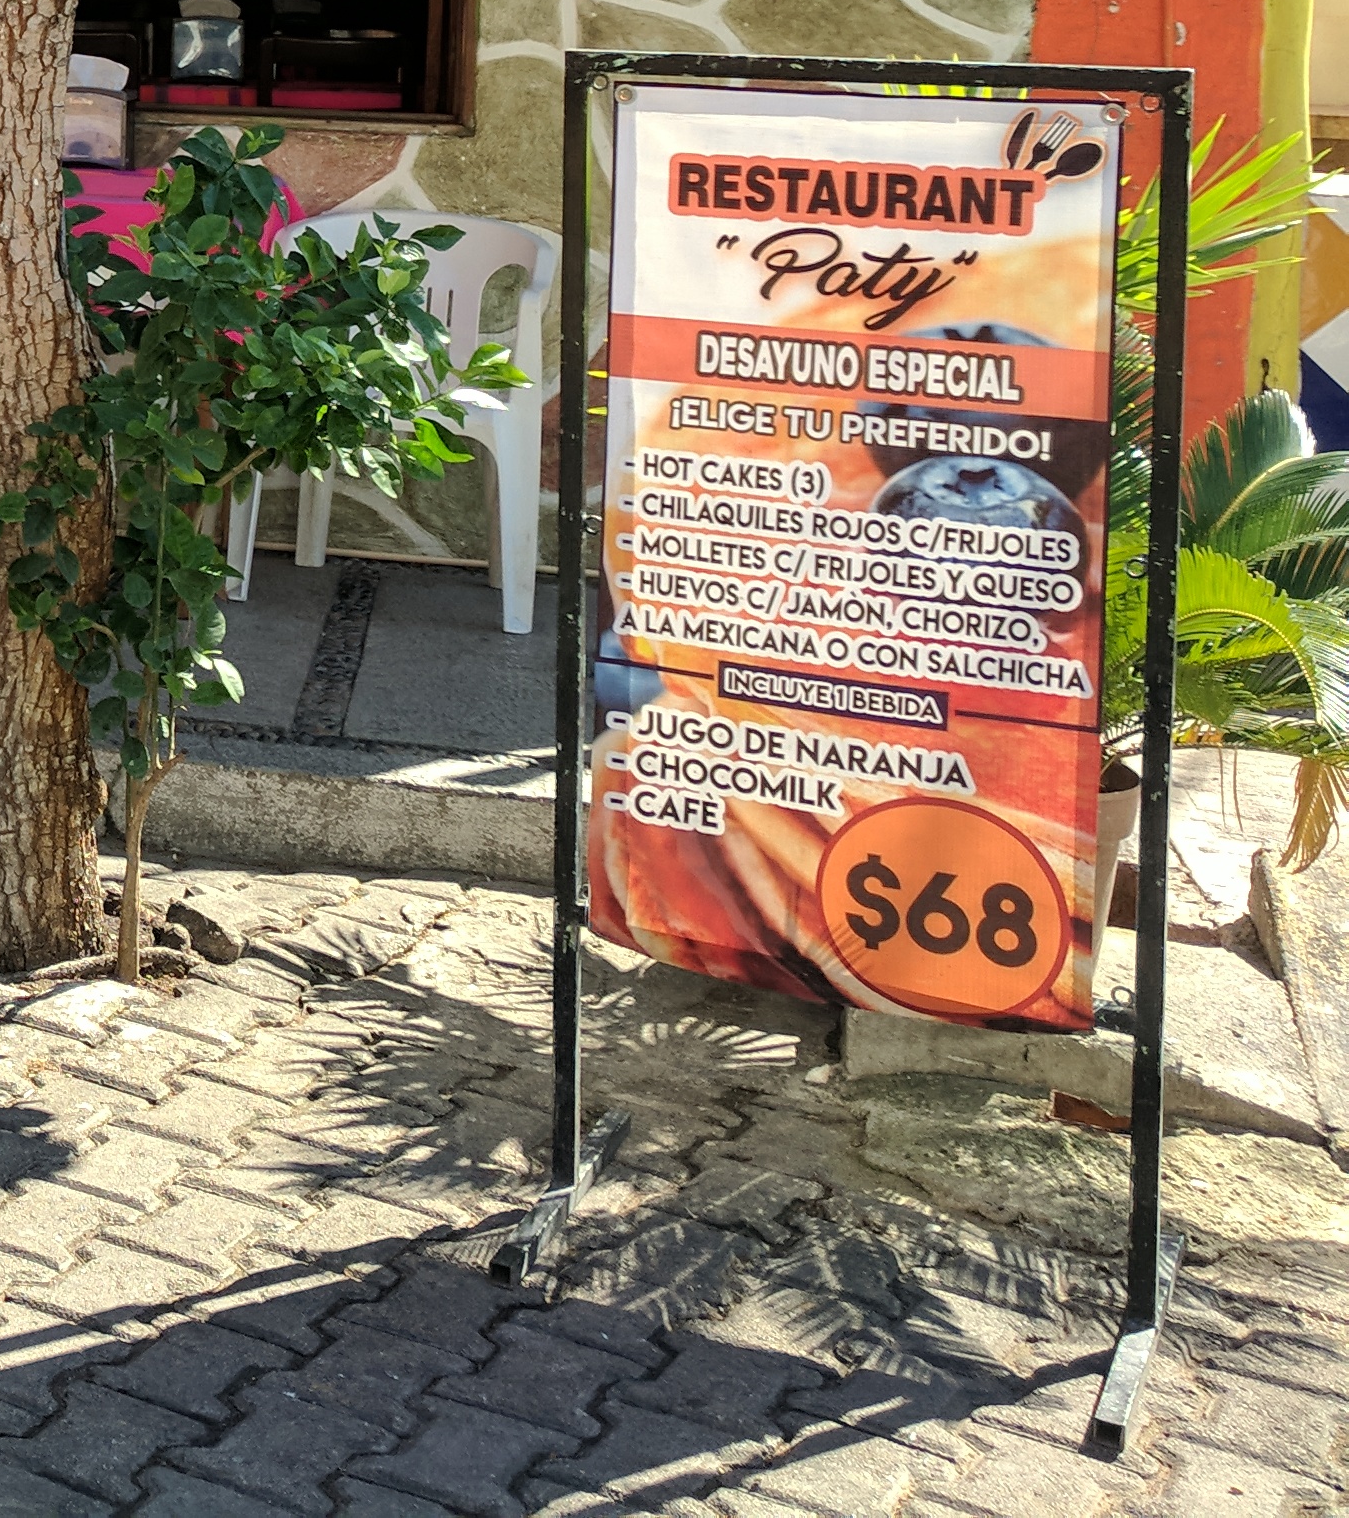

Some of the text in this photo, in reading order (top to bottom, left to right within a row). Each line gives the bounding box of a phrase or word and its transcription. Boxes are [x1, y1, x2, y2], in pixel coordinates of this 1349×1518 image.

[678, 162, 1035, 227] RESTAURANT
[699, 333, 1022, 402] DESAYUNO ESPECIAL
[670, 398, 1052, 461] ¡ELIGE TU PREFERIDO!
[643, 453, 825, 501] HOT CAKES (3)
[641, 493, 1072, 563] CHILAQUILES ROJOS C/FRIJOLES
[640, 531, 1074, 605] MOLLETES C/ FRIJOLES Y QUESO
[639, 570, 739, 606] HUEVOS
[747, 585, 779, 614] C/
[901, 606, 1040, 647] CHORIZO,
[620, 607, 1086, 693] A LA MEXICANA O CON SALCHICHA
[726, 670, 942, 722] INCLUYE 1 BEBIDA
[635, 751, 838, 811] CHOCOMILK
[637, 711, 970, 789] JUGO DE NARANJA
[845, 852, 1039, 969] $68
